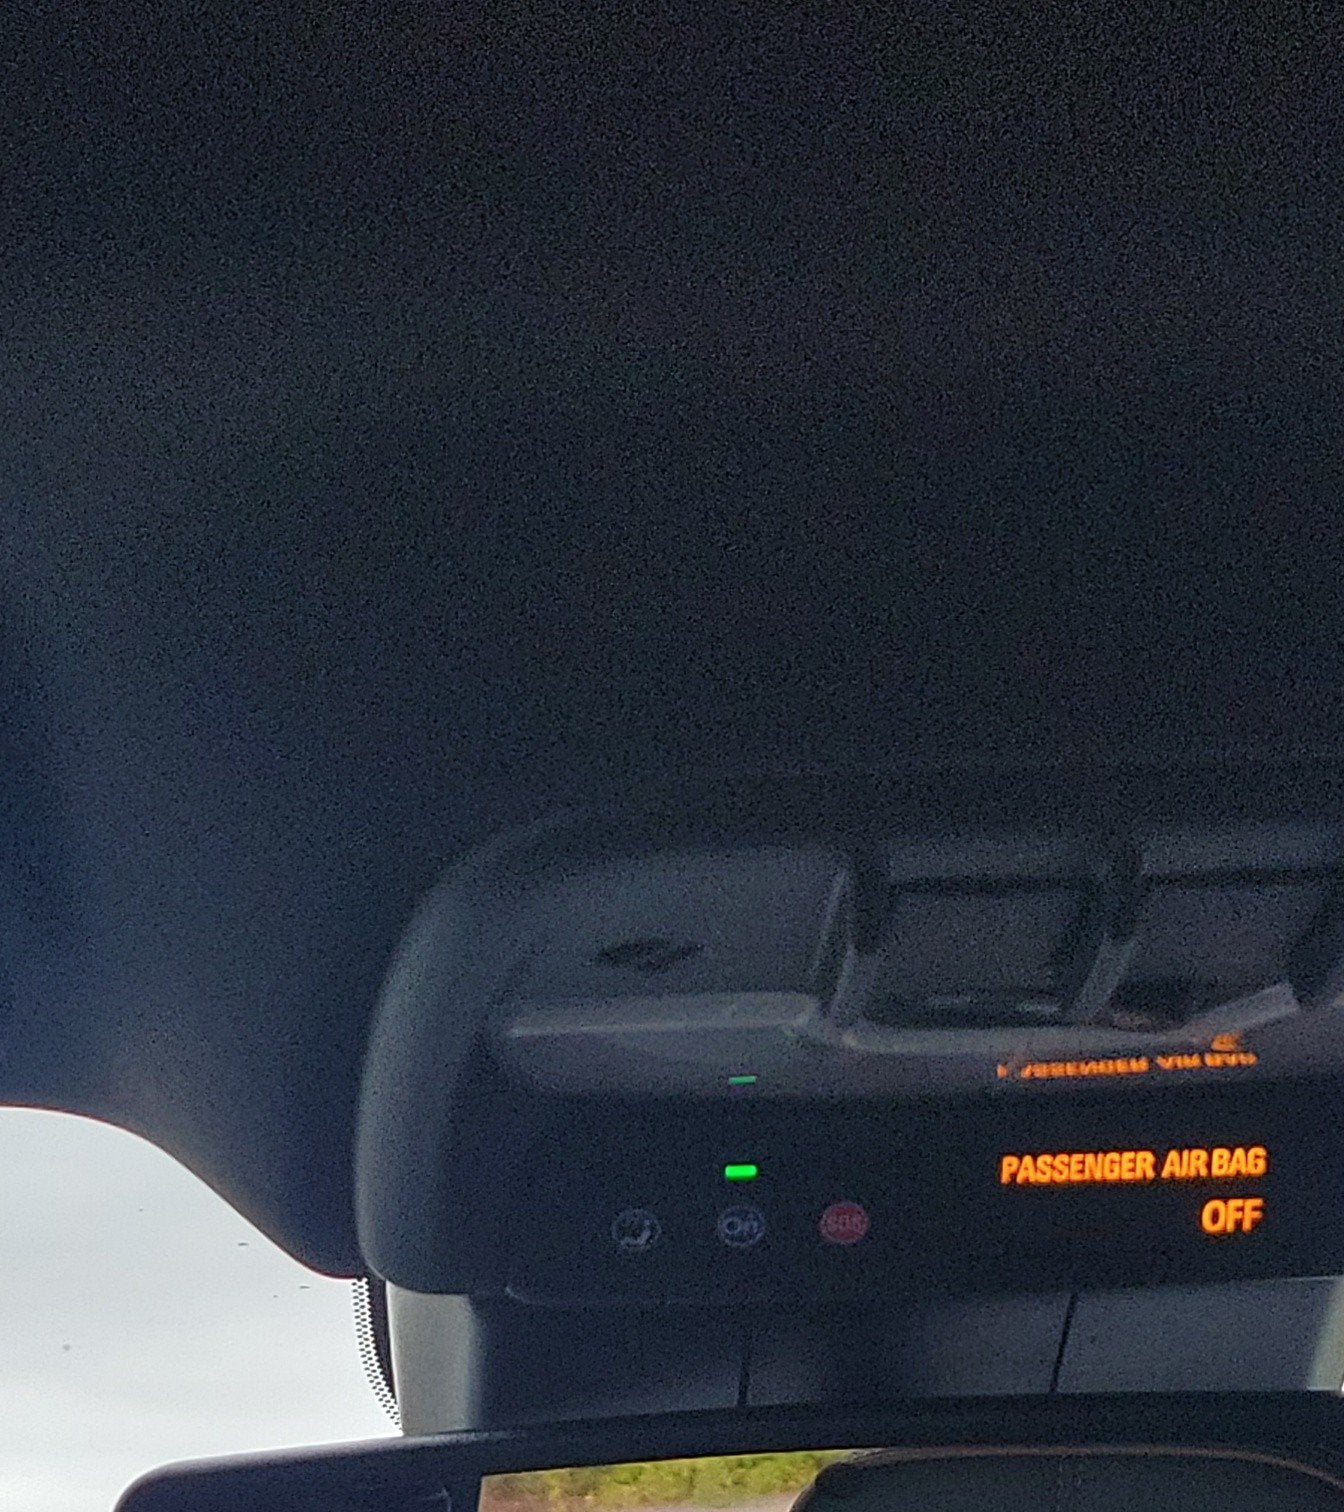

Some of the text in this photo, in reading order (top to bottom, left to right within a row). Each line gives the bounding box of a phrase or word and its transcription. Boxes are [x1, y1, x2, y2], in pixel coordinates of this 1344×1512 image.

[1000, 1147, 1267, 1184] PASSENGER AIR BAG
[1202, 1197, 1264, 1233] OFF
